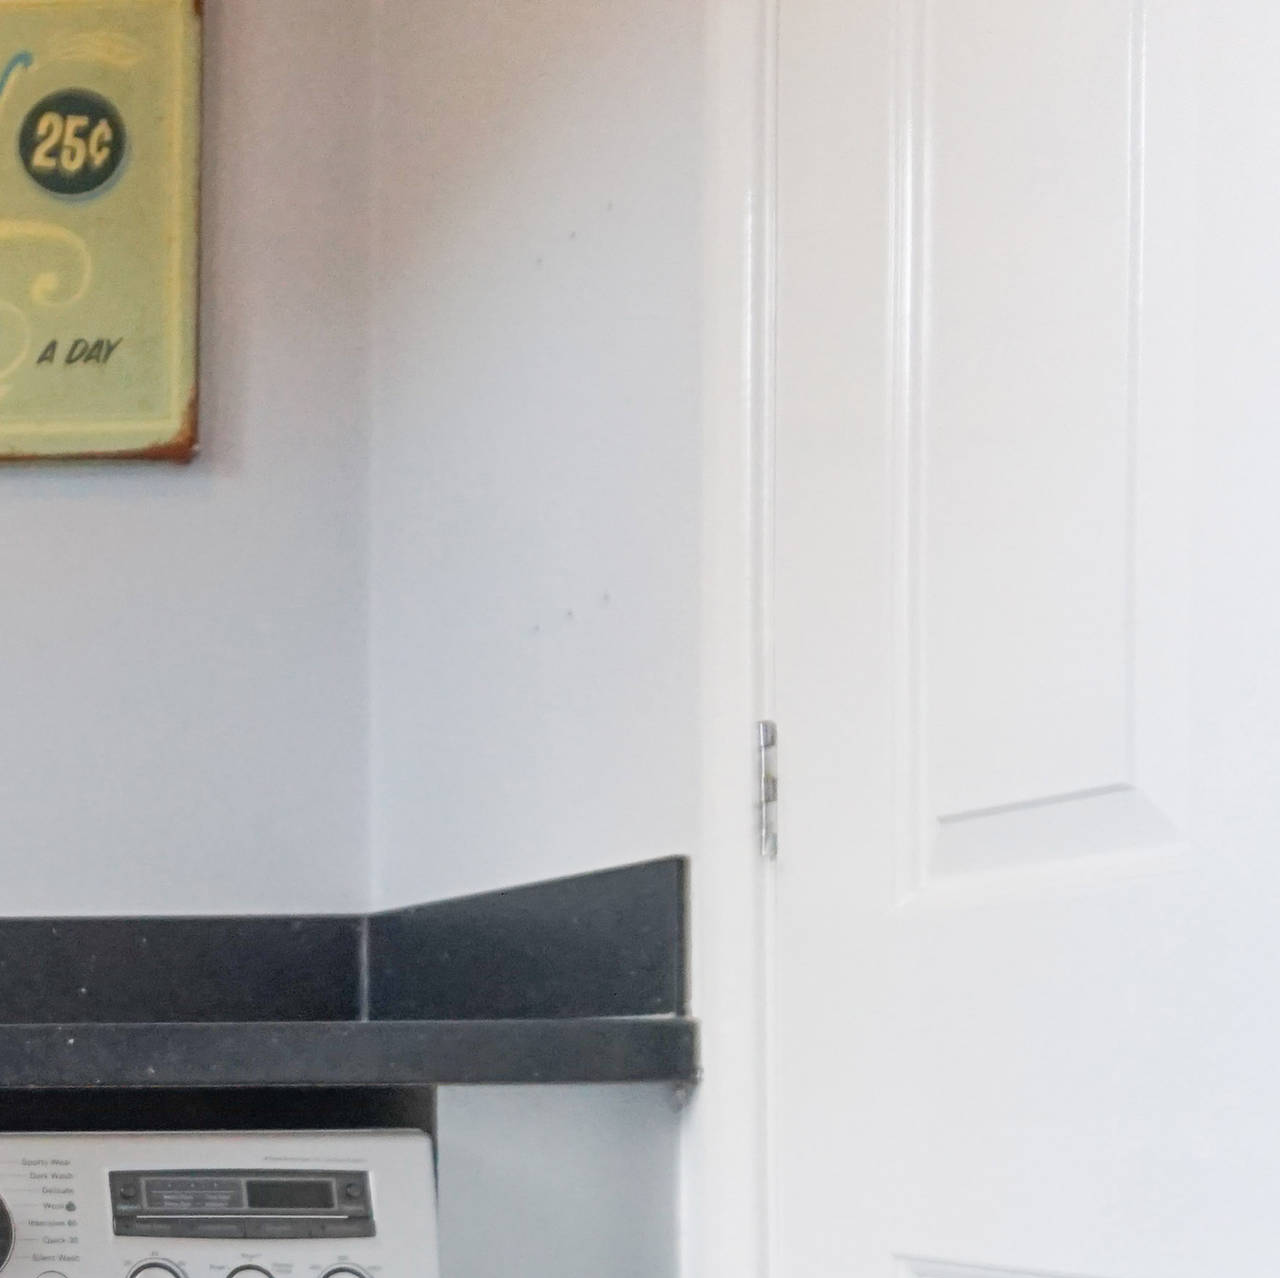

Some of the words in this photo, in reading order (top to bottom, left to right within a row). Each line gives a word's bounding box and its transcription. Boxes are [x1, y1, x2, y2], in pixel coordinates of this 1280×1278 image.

[31, 111, 113, 173] 25¢
[37, 339, 59, 365] A
[65, 337, 123, 365] DAY
